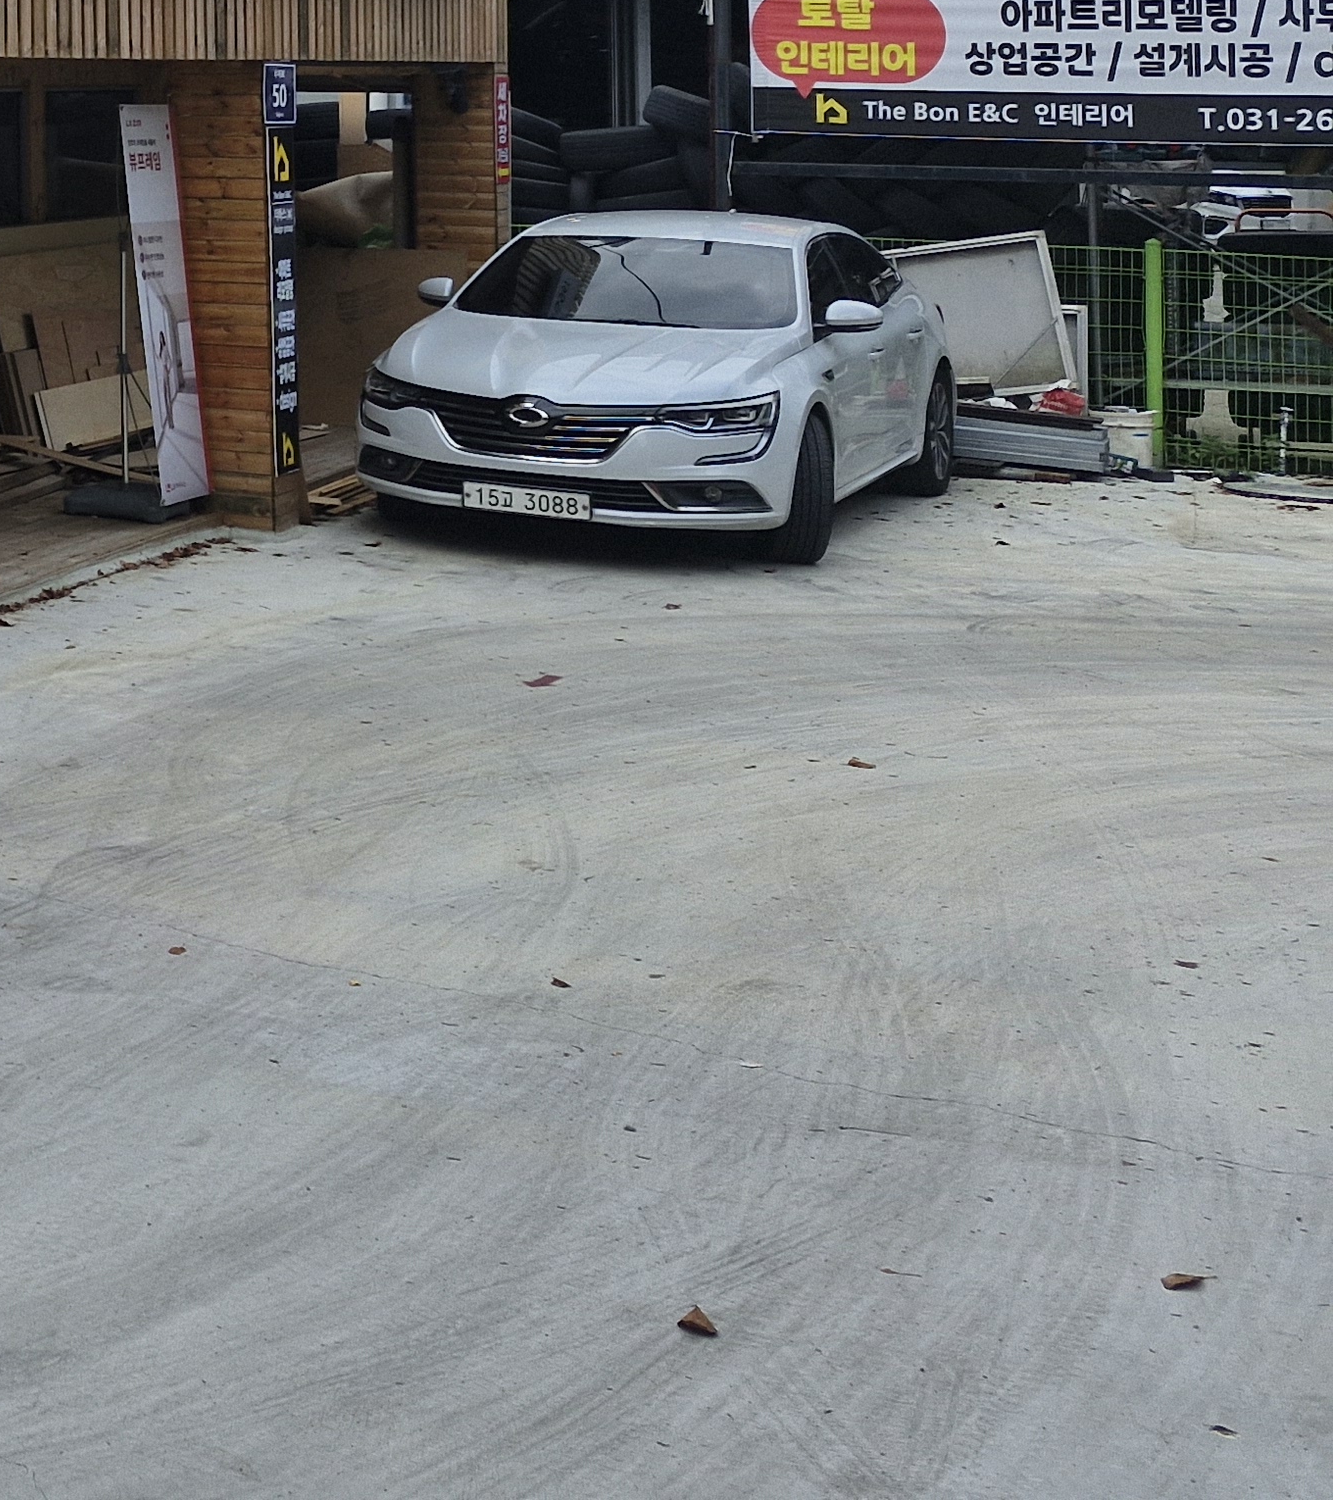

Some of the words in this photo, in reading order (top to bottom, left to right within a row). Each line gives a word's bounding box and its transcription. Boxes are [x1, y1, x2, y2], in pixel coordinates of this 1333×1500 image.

[775, 40, 917, 76] 인테리어
[965, 42, 1096, 77] 상업공간
[1133, 43, 1273, 78] 설계시공
[272, 84, 287, 108] 50
[863, 100, 906, 120] The
[913, 102, 959, 122] Bon
[968, 104, 1019, 123] E&C
[1034, 103, 1134, 128] 인테리어
[129, 152, 161, 172] 뷰프레임
[475, 487, 513, 508] 15고
[525, 492, 579, 515] 3088
